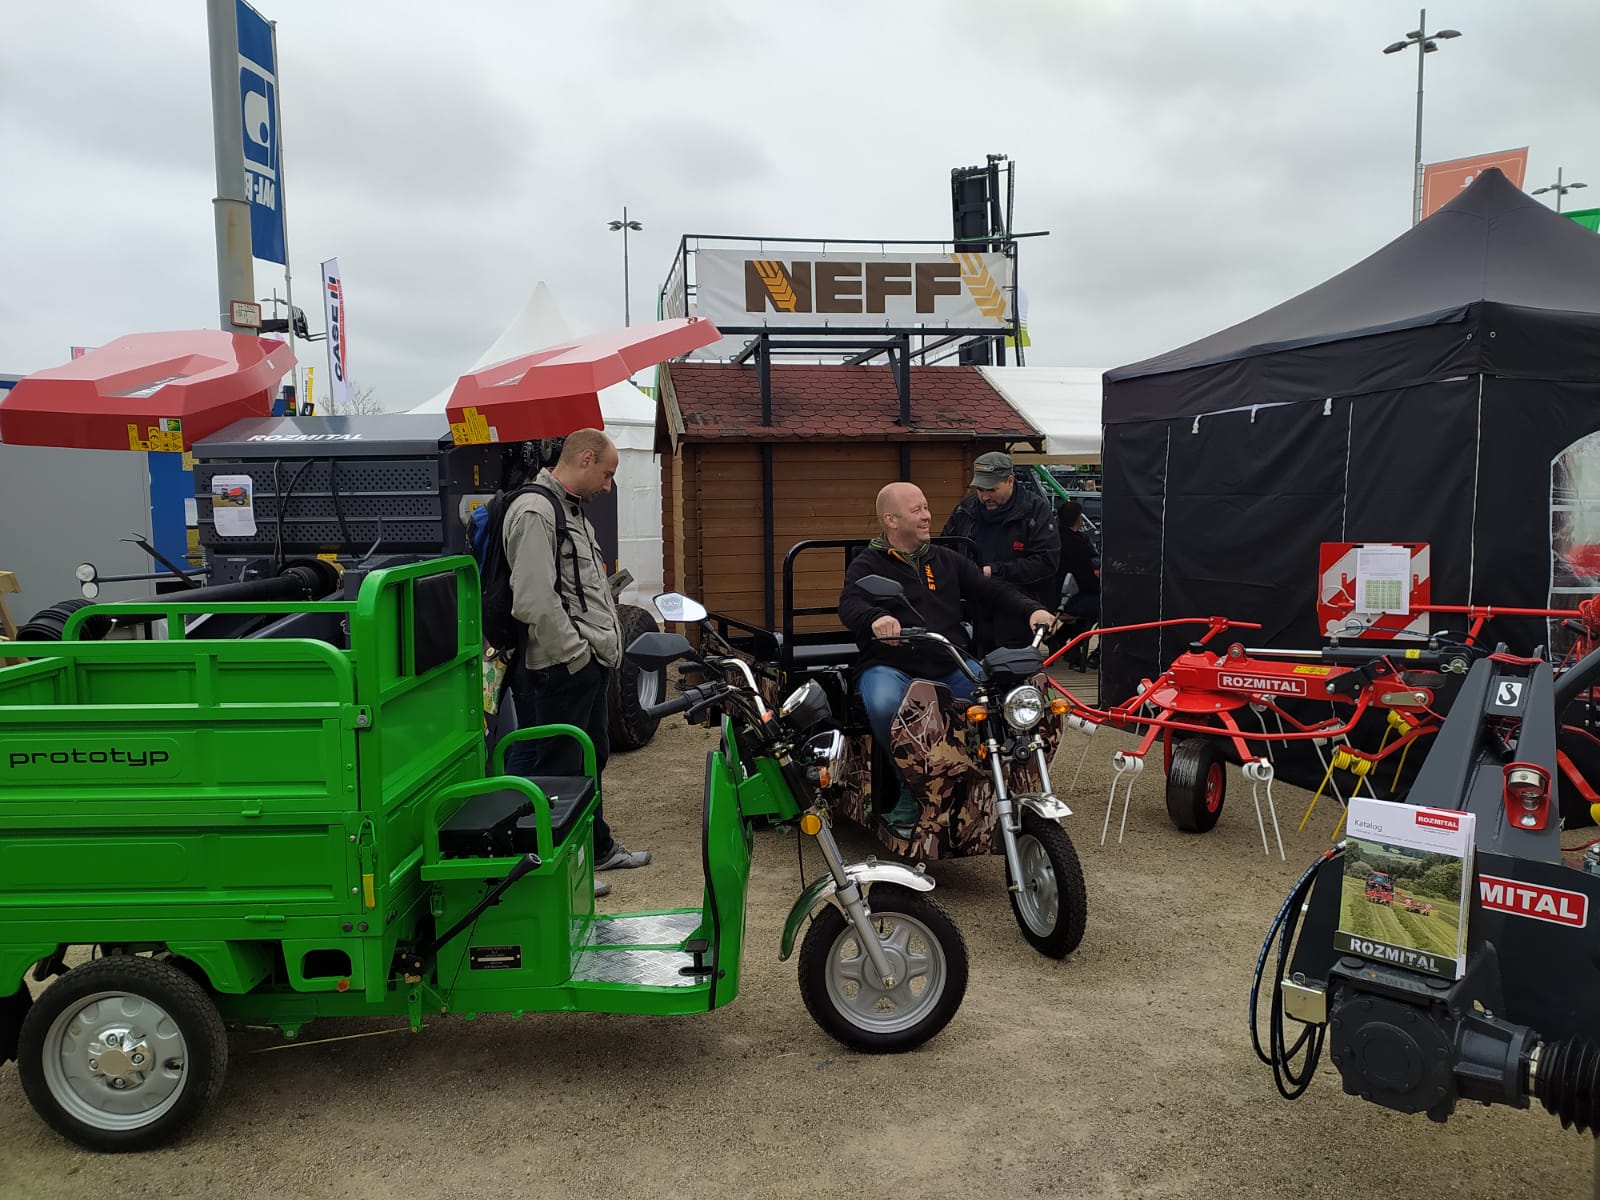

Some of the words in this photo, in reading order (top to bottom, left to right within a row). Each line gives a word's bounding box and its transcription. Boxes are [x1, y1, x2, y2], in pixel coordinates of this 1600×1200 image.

[744, 260, 962, 314] NEFF
[331, 304, 343, 383] CASE
[246, 433, 364, 442] ROZMITAL
[1222, 675, 1301, 693] ROZMITAL
[9, 747, 170, 769] prototyp
[1354, 818, 1383, 833] Katalog
[1417, 815, 1458, 829] ROZMITAL
[1350, 938, 1440, 973] ROZMITAL
